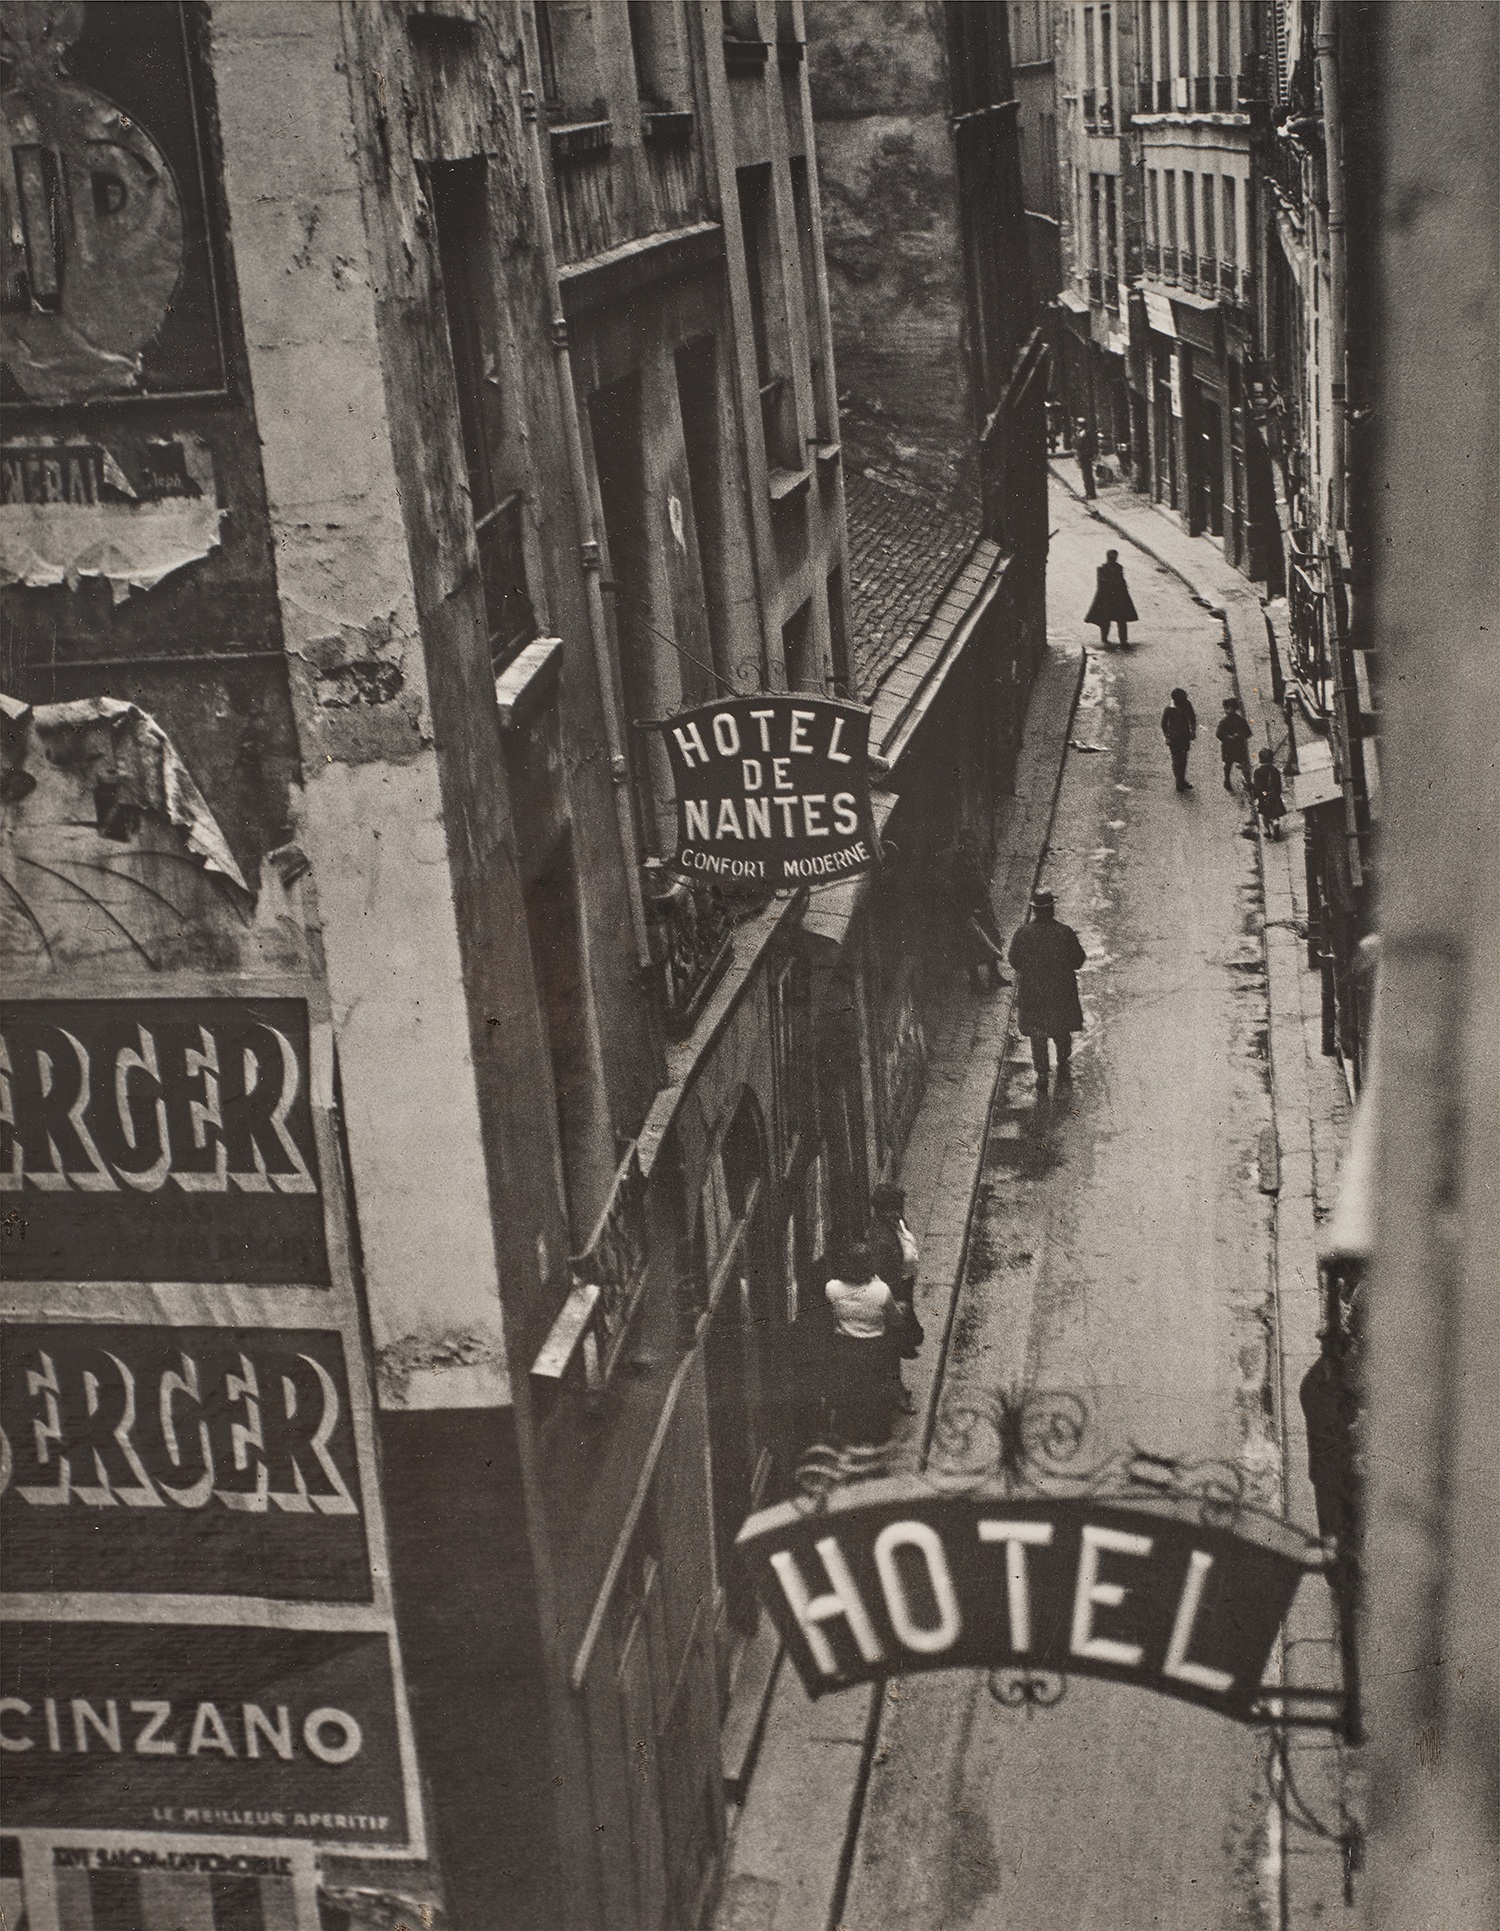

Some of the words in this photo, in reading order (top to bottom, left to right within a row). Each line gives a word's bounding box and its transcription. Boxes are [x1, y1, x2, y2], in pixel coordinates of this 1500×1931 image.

[672, 709, 853, 768] HOTEL
[741, 757, 794, 791] DE
[684, 792, 859, 841] NANTES
[681, 848, 766, 877] CONFORT
[783, 841, 871, 878] MODERNE
[0, 1347, 358, 1515] ERGER
[767, 1519, 1236, 1691] HOTEL
[0, 1696, 363, 1765] CINZANO
[152, 1807, 174, 1821] LE
[183, 1808, 287, 1826] MEILLEUR
